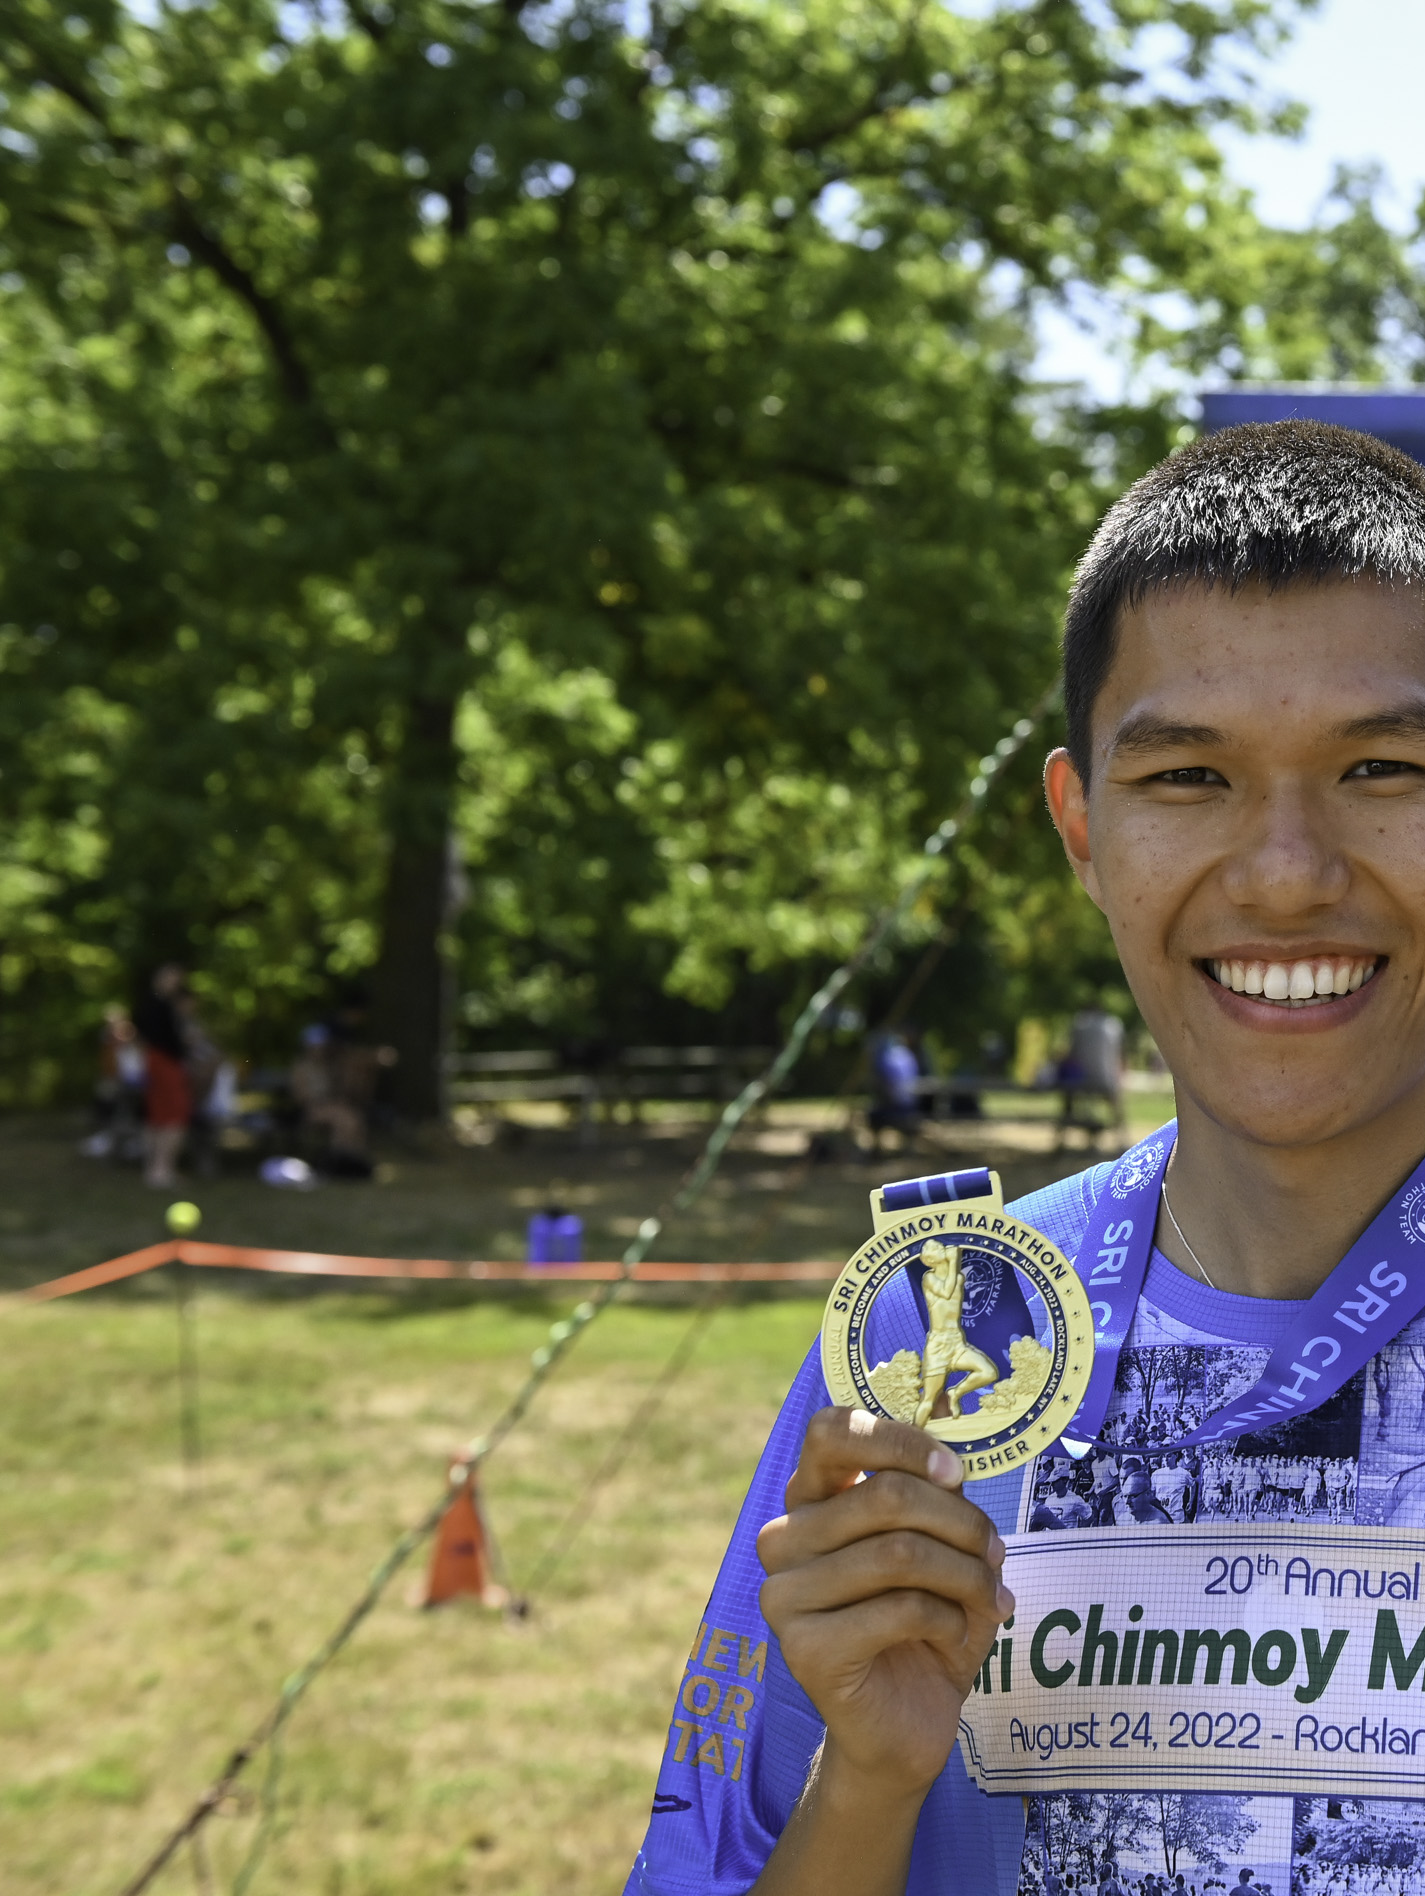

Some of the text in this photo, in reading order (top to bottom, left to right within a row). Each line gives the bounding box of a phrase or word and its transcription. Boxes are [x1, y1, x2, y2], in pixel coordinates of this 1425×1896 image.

[1089, 1219, 1134, 1287] SRI
[1399, 1214, 1417, 1245] TEAM
[834, 1213, 1067, 1313] SRI CHINMOY MARATHON
[851, 1249, 910, 1328] BECOME AND RUN
[961, 1251, 1004, 1317] TEA MARATHON
[1019, 1258, 1037, 1277] AUG.
[1043, 1287, 1058, 1309] 2022
[1333, 1260, 1408, 1335] SRI
[849, 1343, 866, 1388] BECOME
[861, 1389, 879, 1410] AND
[1056, 1319, 1066, 1371] ROCKLAND
[1037, 1397, 1049, 1411] NY
[966, 1440, 1030, 1472] ISHER
[1204, 1553, 1421, 1601] 20th Annual
[973, 1613, 1015, 1695] ri
[1029, 1603, 1350, 1704] Chinmoy
[681, 1668, 755, 1731] OR
[1009, 1712, 1101, 1761] August
[1109, 1711, 1158, 1752] 24,
[1168, 1711, 1261, 1750] 2022
